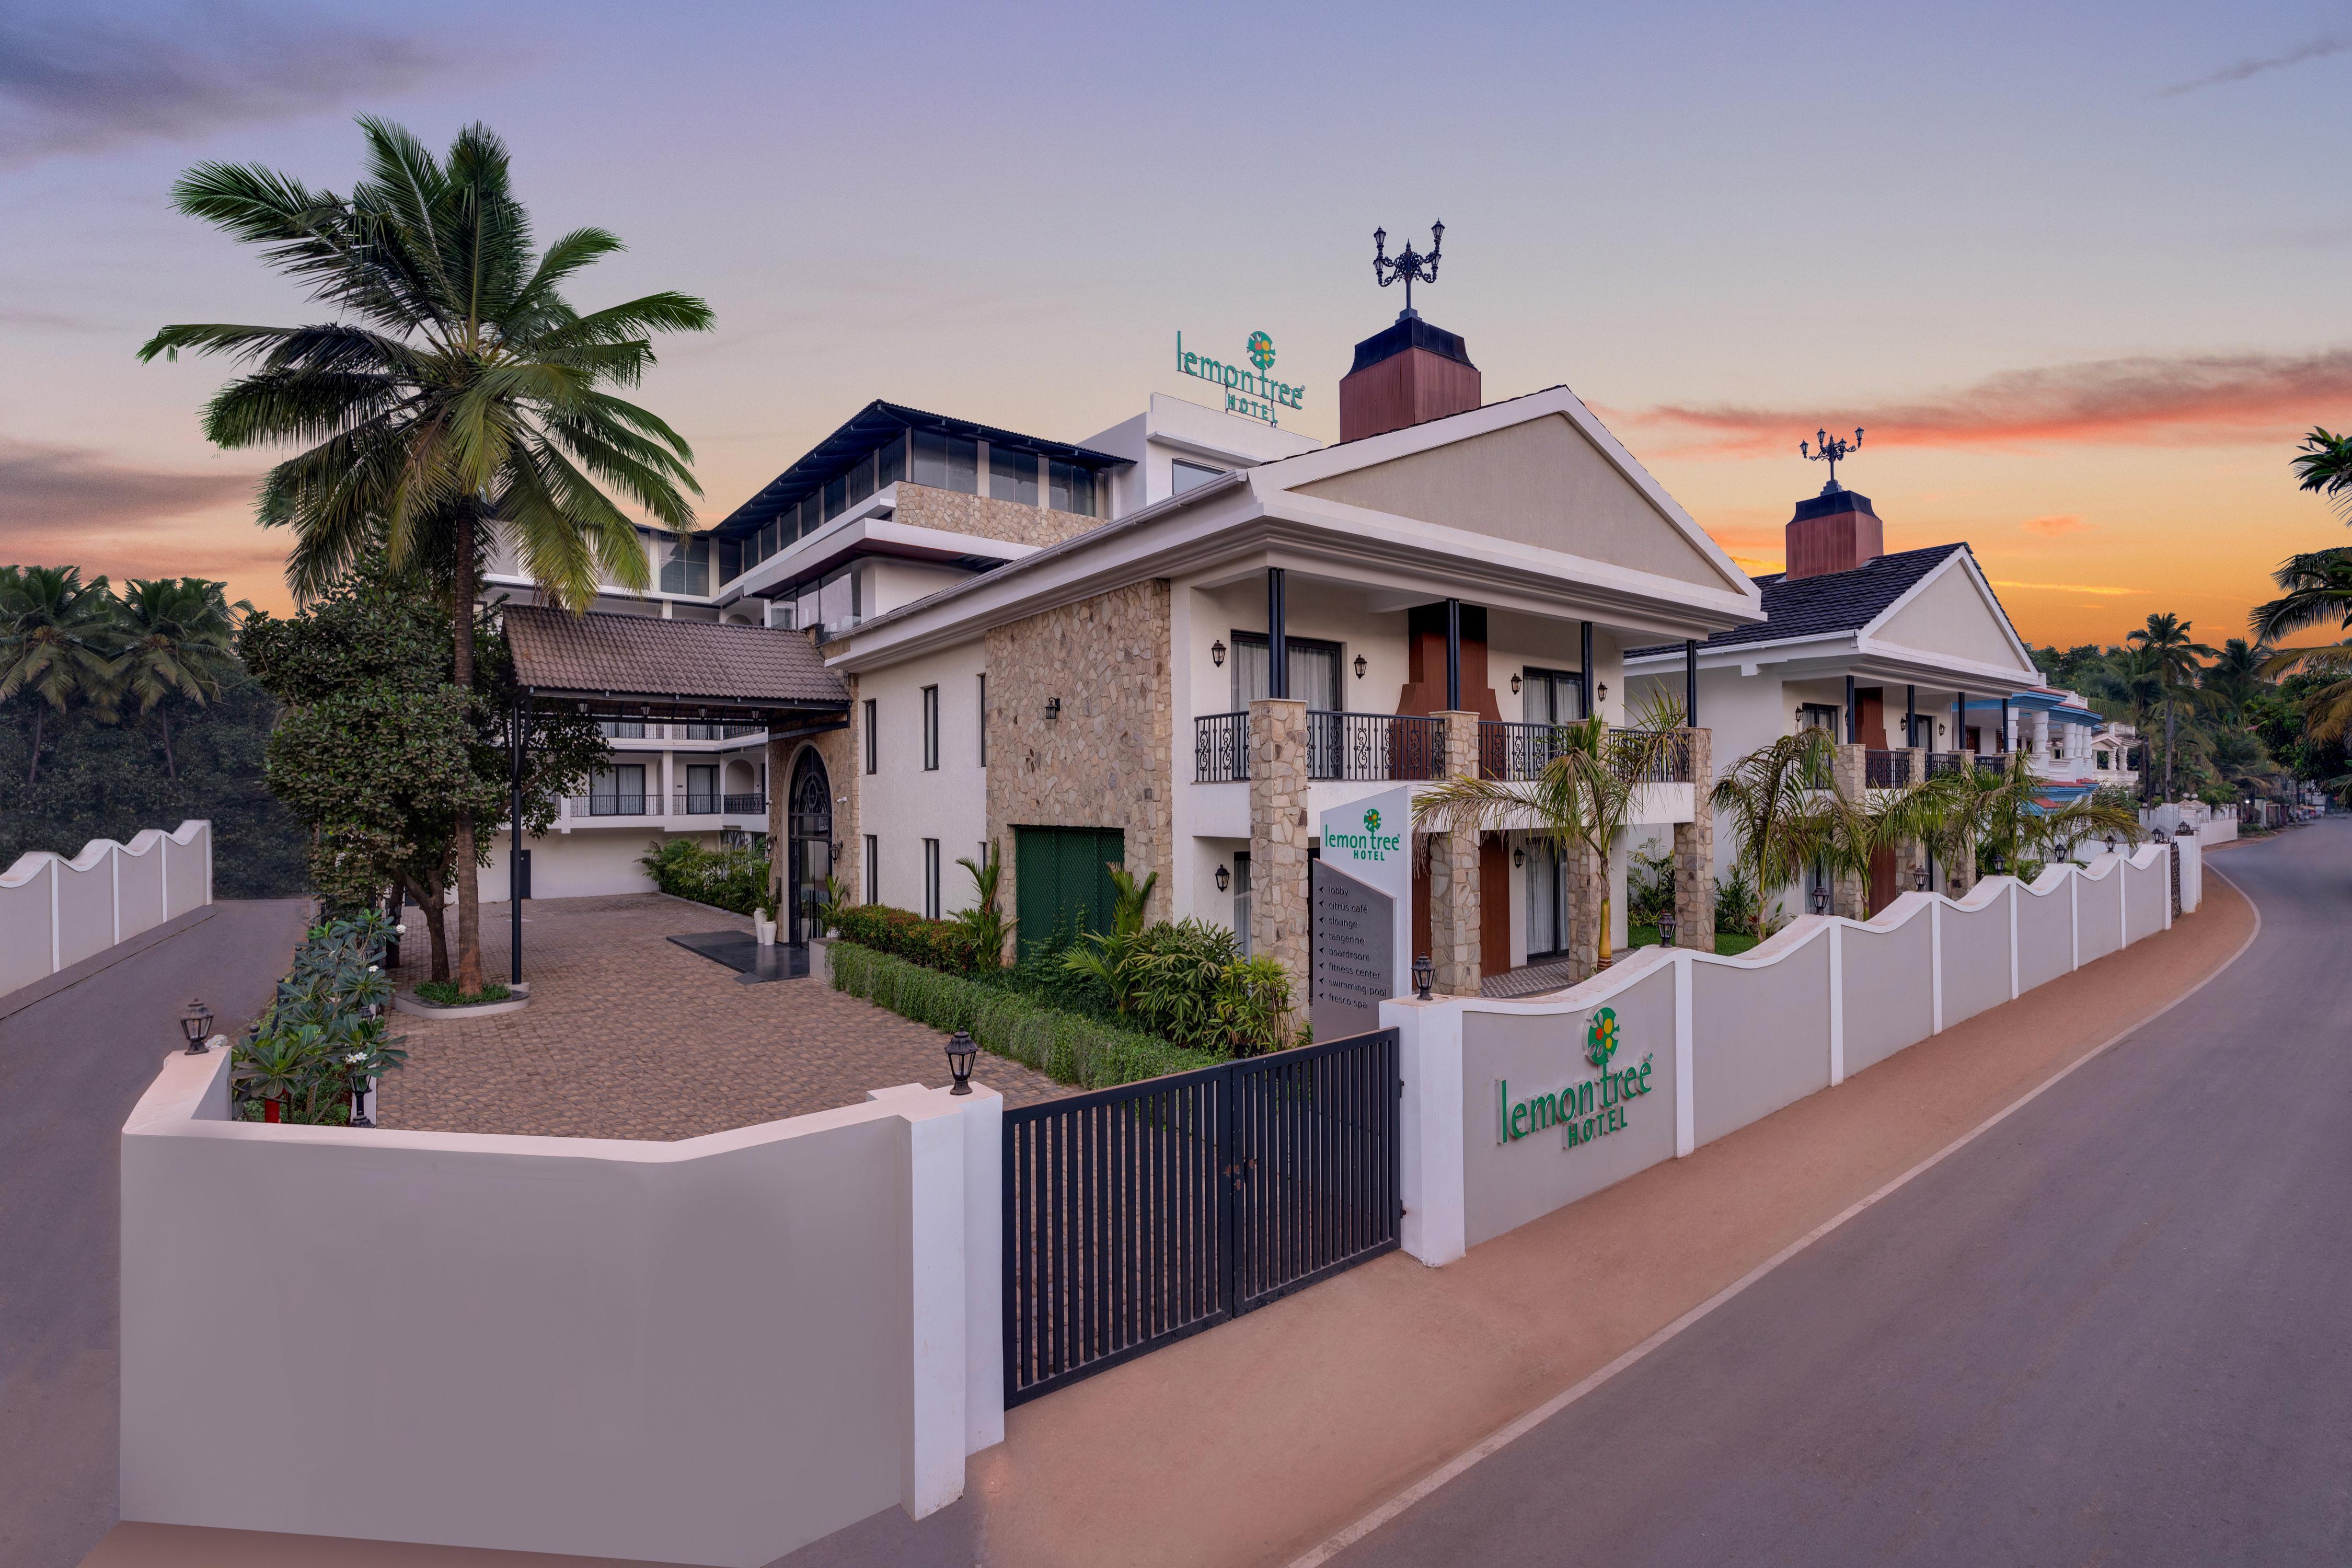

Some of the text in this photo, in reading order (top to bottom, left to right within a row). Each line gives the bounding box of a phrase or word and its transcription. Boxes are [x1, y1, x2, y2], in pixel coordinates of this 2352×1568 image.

[1177, 331, 1303, 410] lemon tree
[1227, 393, 1278, 423] HOTEL
[1325, 824, 1399, 851] lemon tree
[1354, 850, 1385, 861] HOTEL
[1329, 885, 1349, 897] lobby
[1329, 901, 1368, 914] citrus café
[1329, 916, 1358, 929] slounge
[1329, 932, 1365, 944] tangerine
[1329, 947, 1370, 962] boardroom
[1329, 962, 1380, 979] fitness center
[1329, 979, 1387, 997] swimming pool
[1329, 993, 1367, 1009] fresco spa
[1498, 1062, 1652, 1144] lemon tree
[1565, 1106, 1628, 1149] HOTEL
